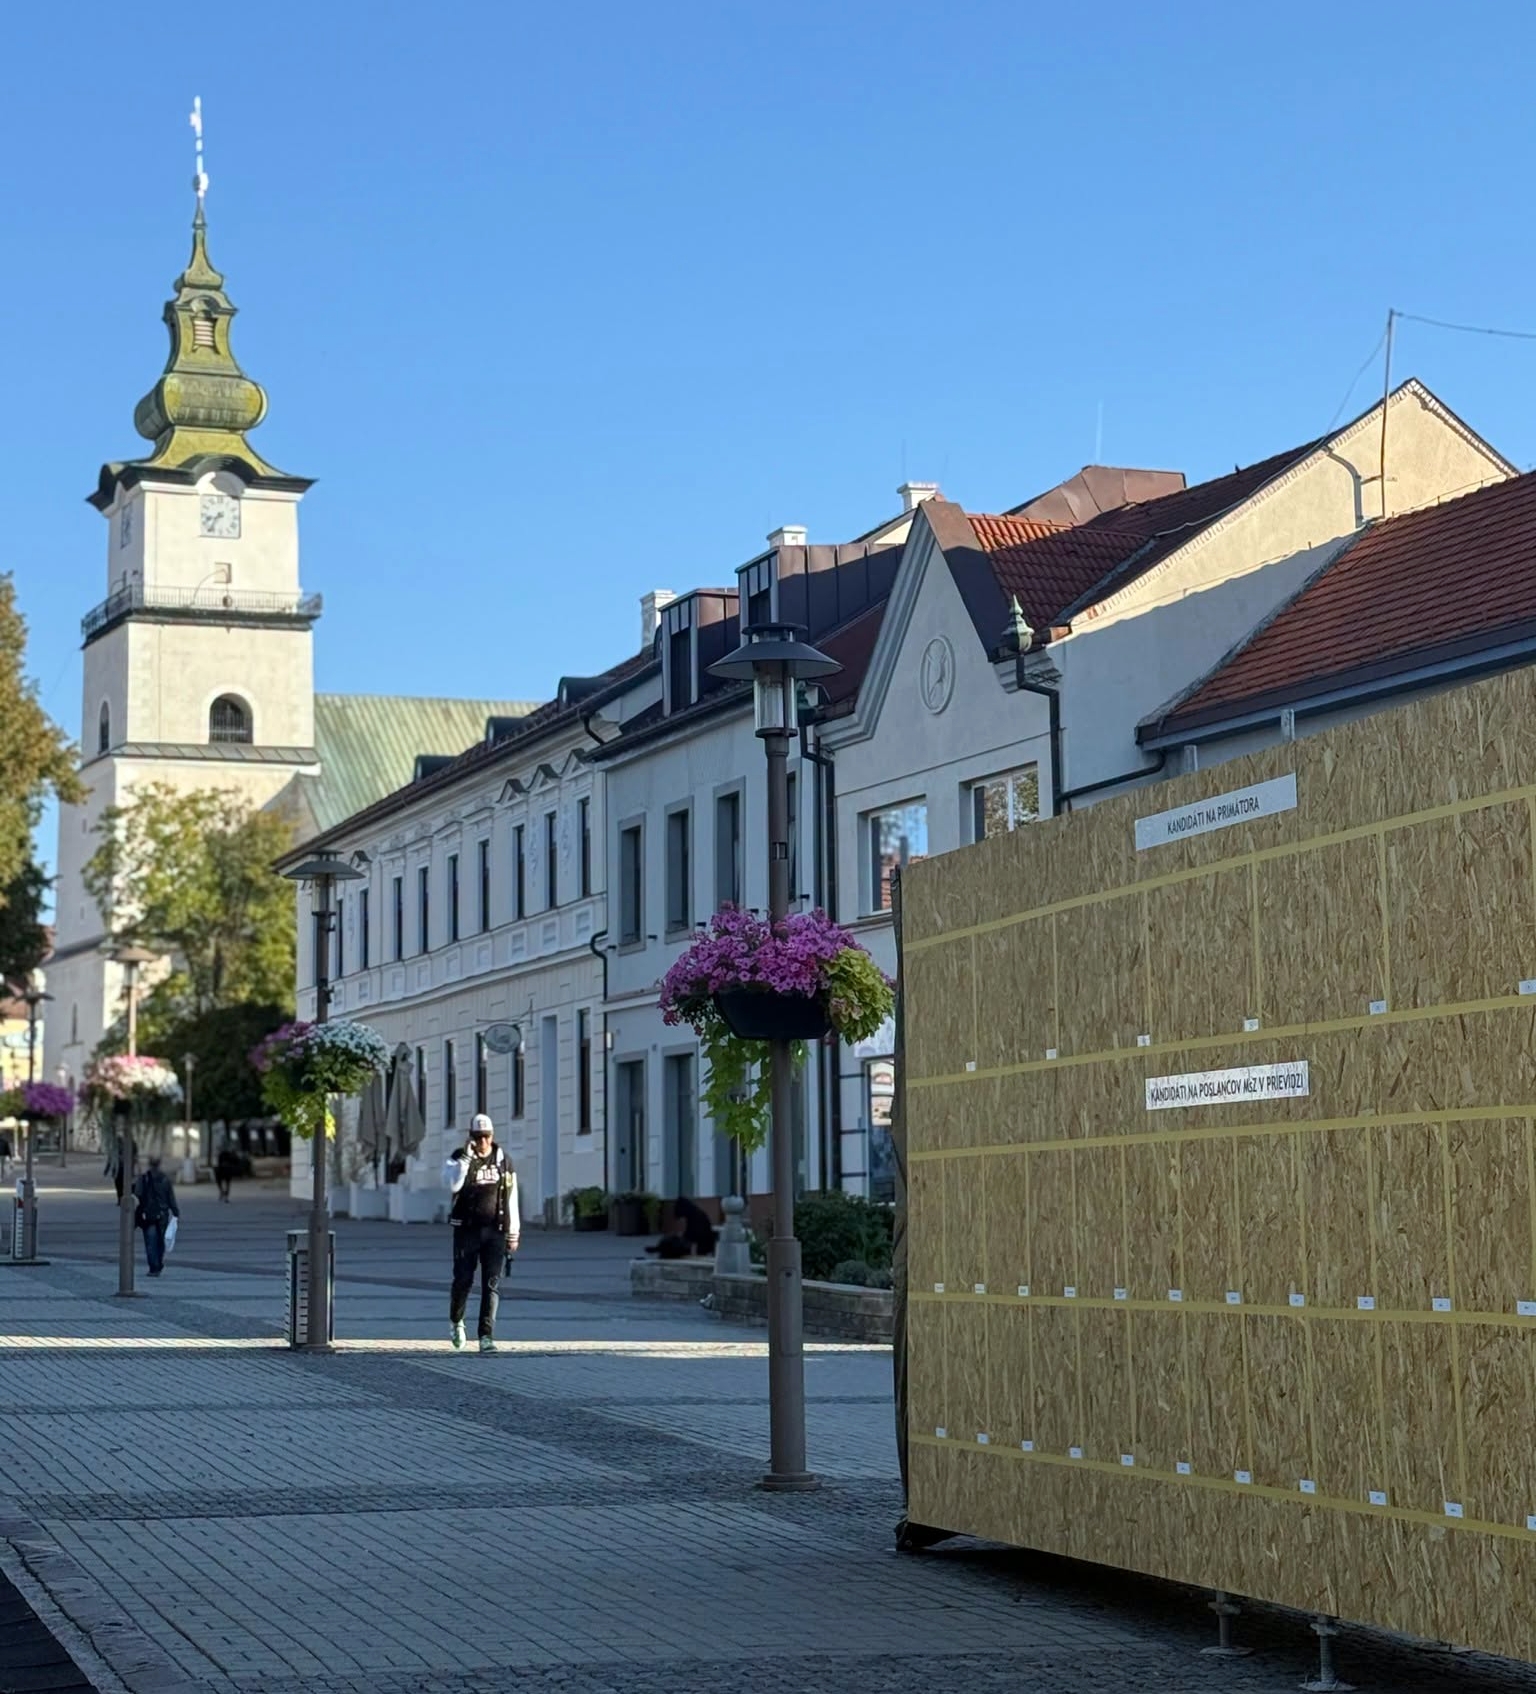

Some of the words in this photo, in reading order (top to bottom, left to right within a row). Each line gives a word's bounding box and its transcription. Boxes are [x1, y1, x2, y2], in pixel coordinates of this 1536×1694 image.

[1167, 808, 1204, 835] KANDIDÁTI
[1206, 808, 1217, 825] NA
[1217, 797, 1260, 821] PRIMÁTORA
[1187, 1083, 1199, 1100] NA
[1199, 1078, 1241, 1098] POSLANCOV
[1258, 1076, 1265, 1092] V
